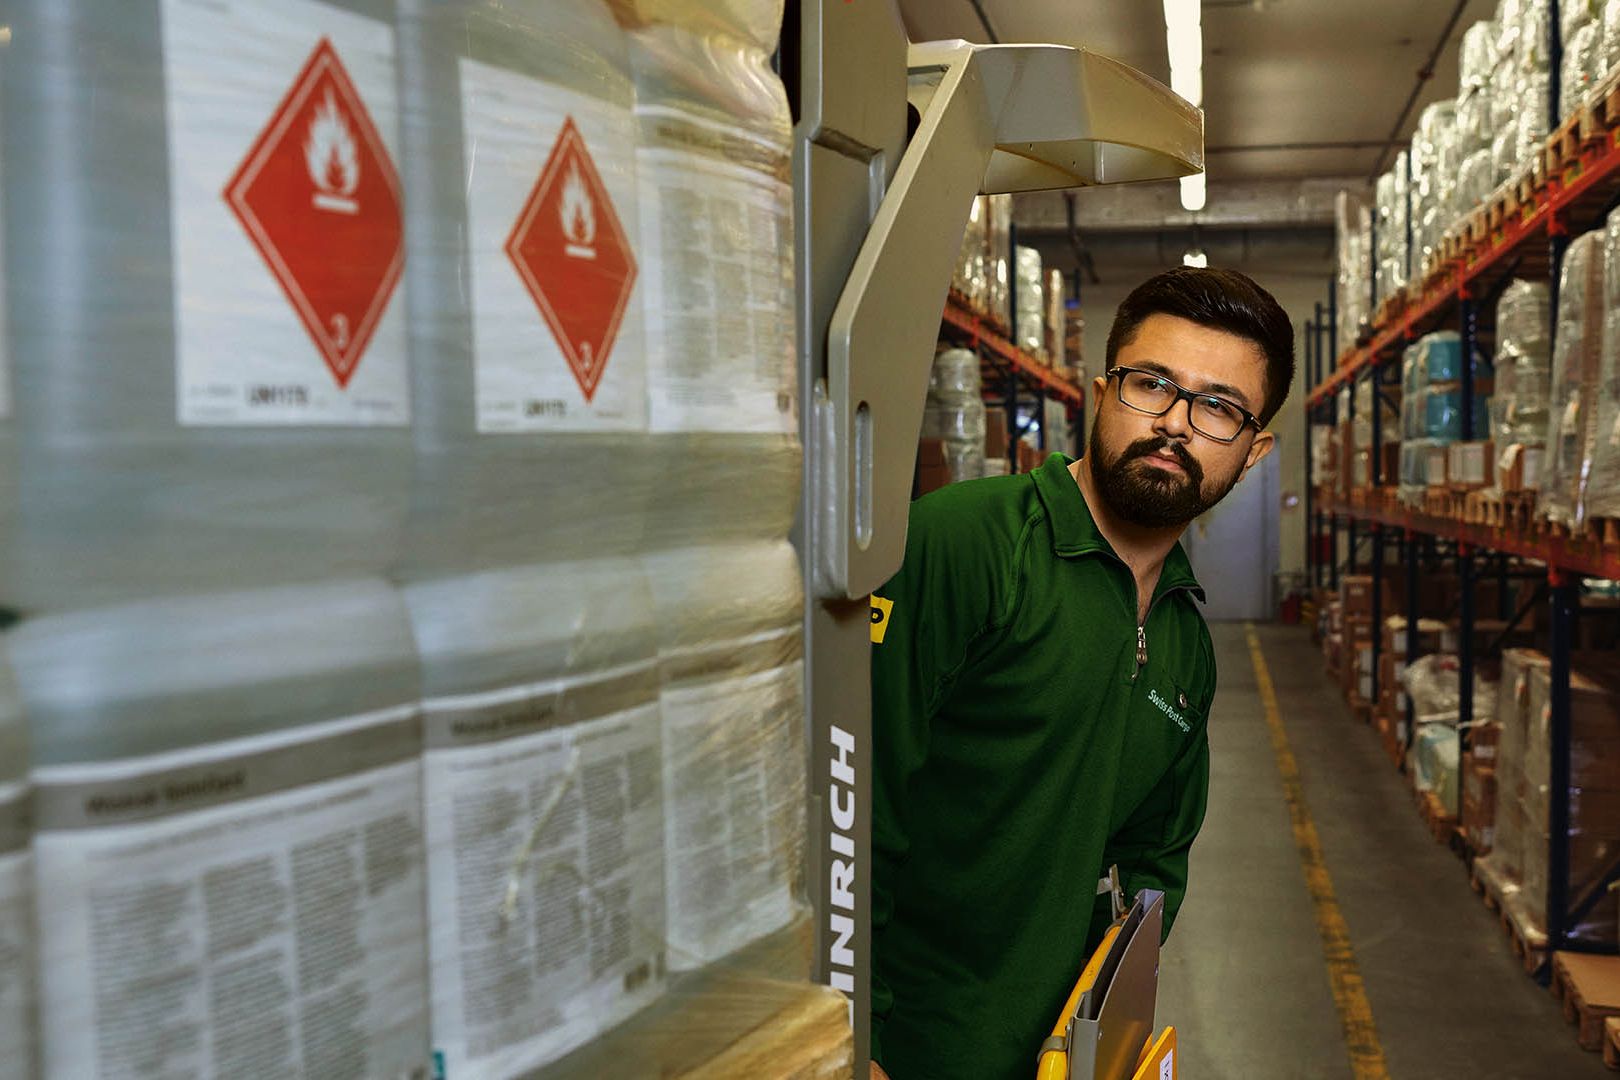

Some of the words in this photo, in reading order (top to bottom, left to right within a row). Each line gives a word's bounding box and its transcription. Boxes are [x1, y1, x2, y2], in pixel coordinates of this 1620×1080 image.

[331, 313, 349, 348] 3
[580, 341, 593, 370] 3
[1148, 689, 1168, 711] Swiss
[1165, 705, 1179, 722] Post
[830, 724, 855, 1026] INRICH
